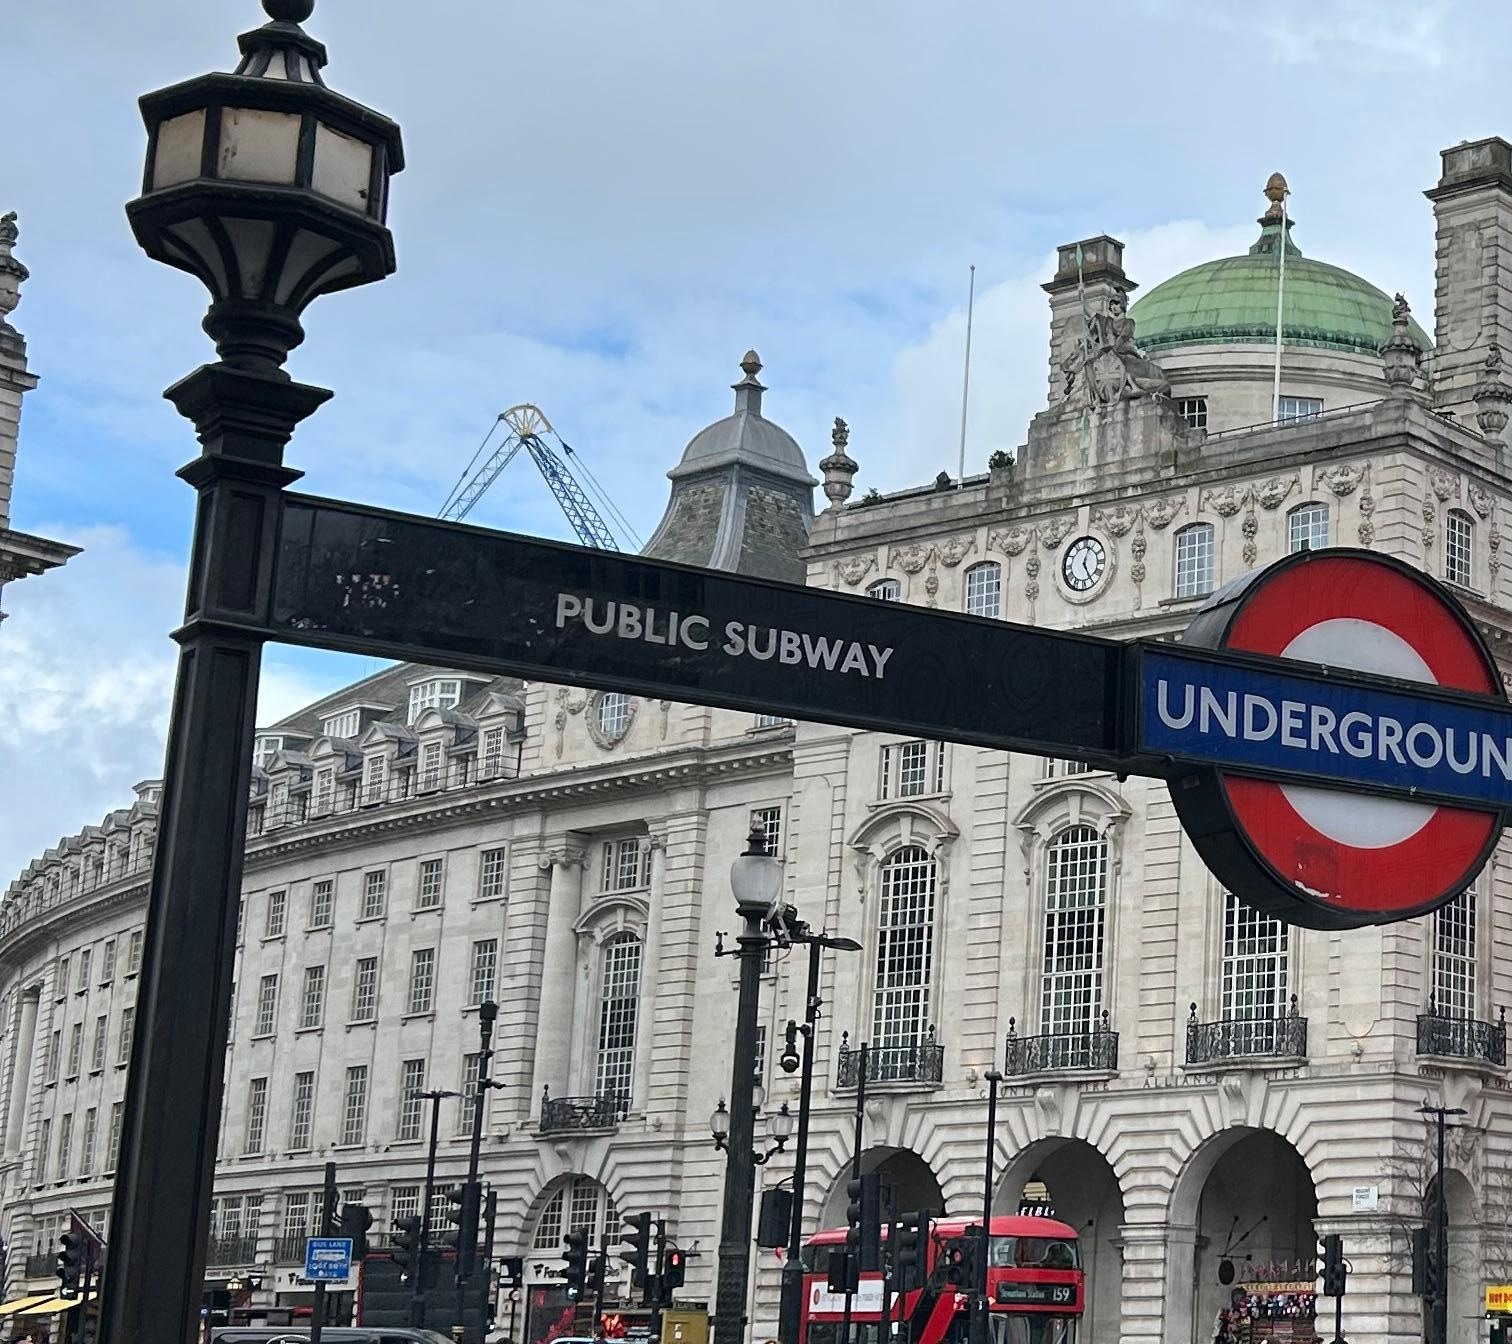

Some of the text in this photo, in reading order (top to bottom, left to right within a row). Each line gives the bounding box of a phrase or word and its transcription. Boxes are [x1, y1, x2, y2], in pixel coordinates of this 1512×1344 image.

[556, 592, 893, 679] PUBLIC SUBWAY
[979, 1084, 1036, 1099] CUNTY
[1076, 1081, 1110, 1093] FIRE
[1053, 1287, 1070, 1301] 159
